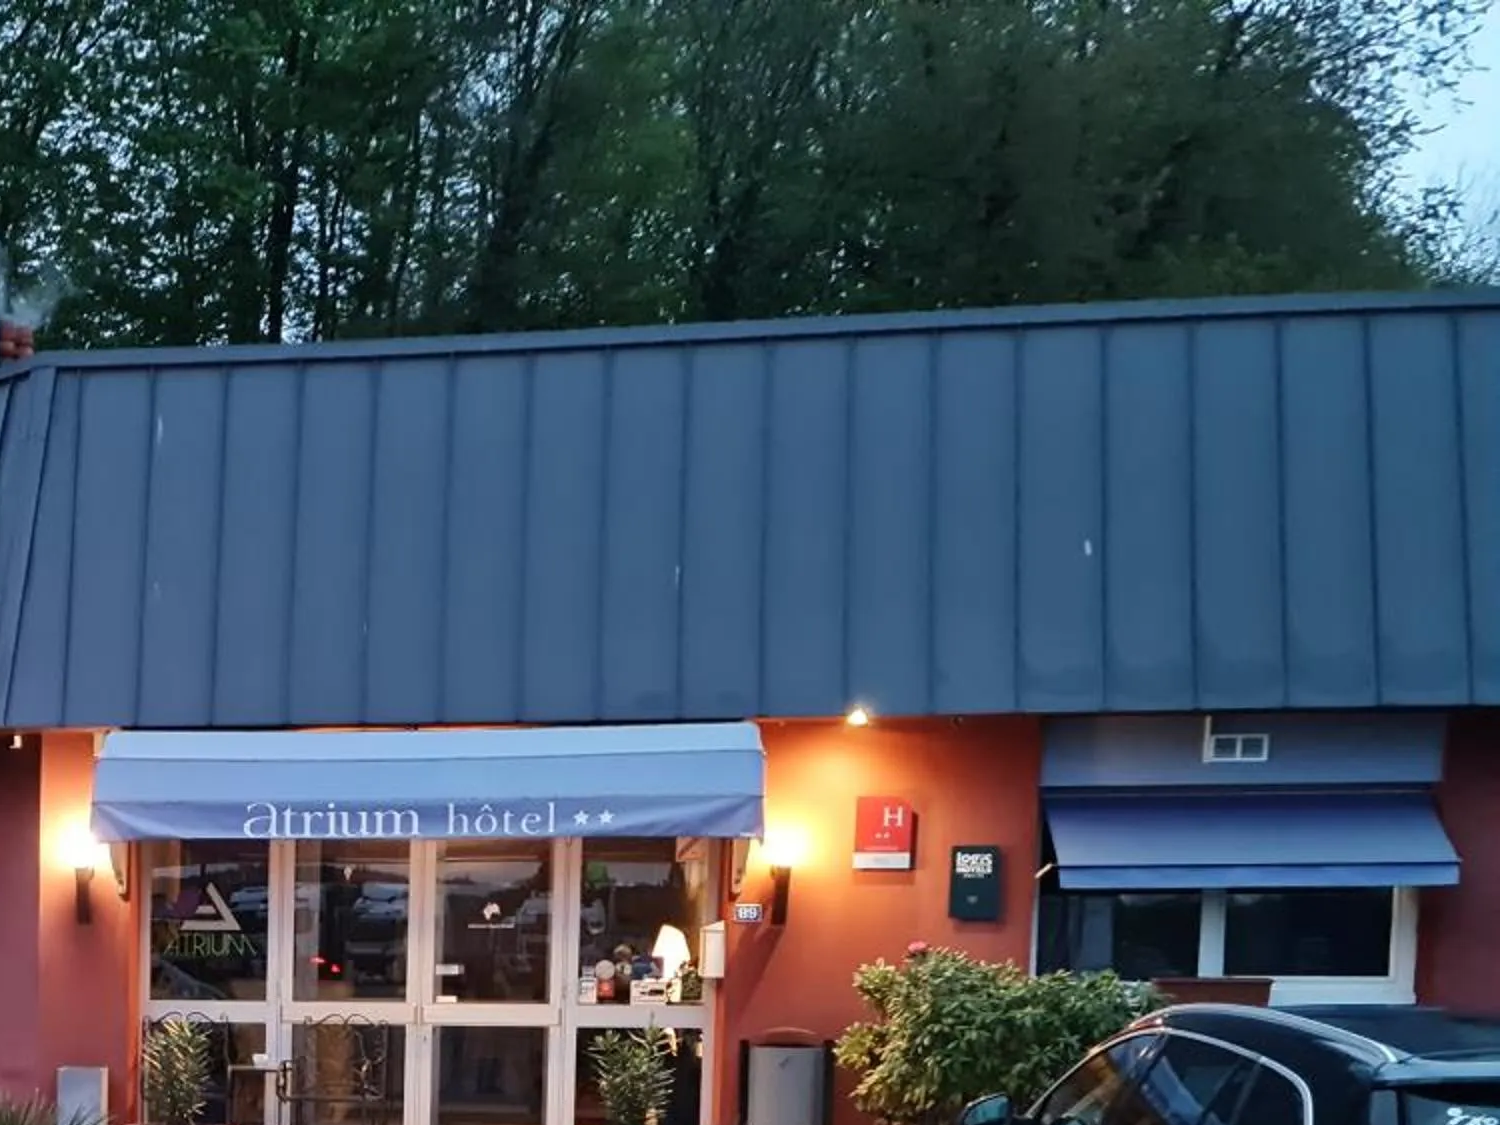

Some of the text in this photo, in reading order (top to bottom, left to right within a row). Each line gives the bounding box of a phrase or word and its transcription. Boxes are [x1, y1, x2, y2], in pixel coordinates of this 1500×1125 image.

[243, 801, 557, 839] atrium hôtel
[883, 806, 904, 827] H
[163, 933, 257, 957] ATRIUM
